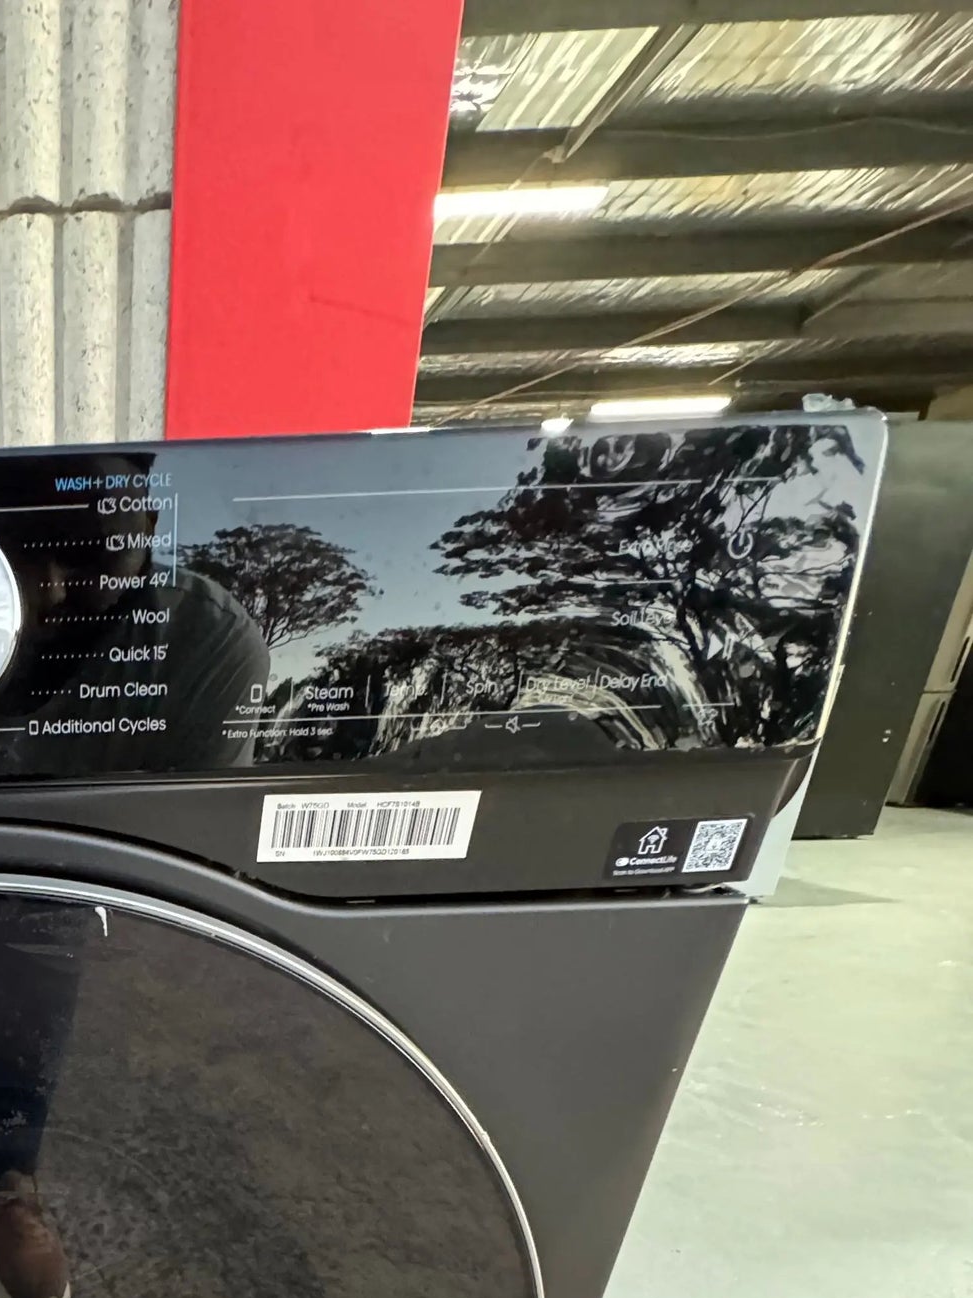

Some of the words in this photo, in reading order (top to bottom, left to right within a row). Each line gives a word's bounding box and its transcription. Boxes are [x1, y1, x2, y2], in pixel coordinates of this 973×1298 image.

[133, 473, 172, 488] CYCLE
[119, 496, 172, 512] Cotton
[127, 532, 171, 549] Mixed
[100, 574, 146, 590] Power
[132, 608, 170, 624] Wool
[610, 610, 637, 626] Soil
[109, 646, 150, 663] Quick
[80, 684, 120, 699] Drum
[123, 682, 167, 697] Clean
[466, 681, 498, 698] Spin
[526, 676, 549, 695] Dry
[600, 674, 640, 692] Delay
[641, 674, 668, 688] End
[305, 686, 354, 700] Steam
[326, 702, 350, 712] Wash
[42, 719, 115, 735] Additional
[118, 717, 166, 735] Cycles
[227, 729, 248, 739] Extra
